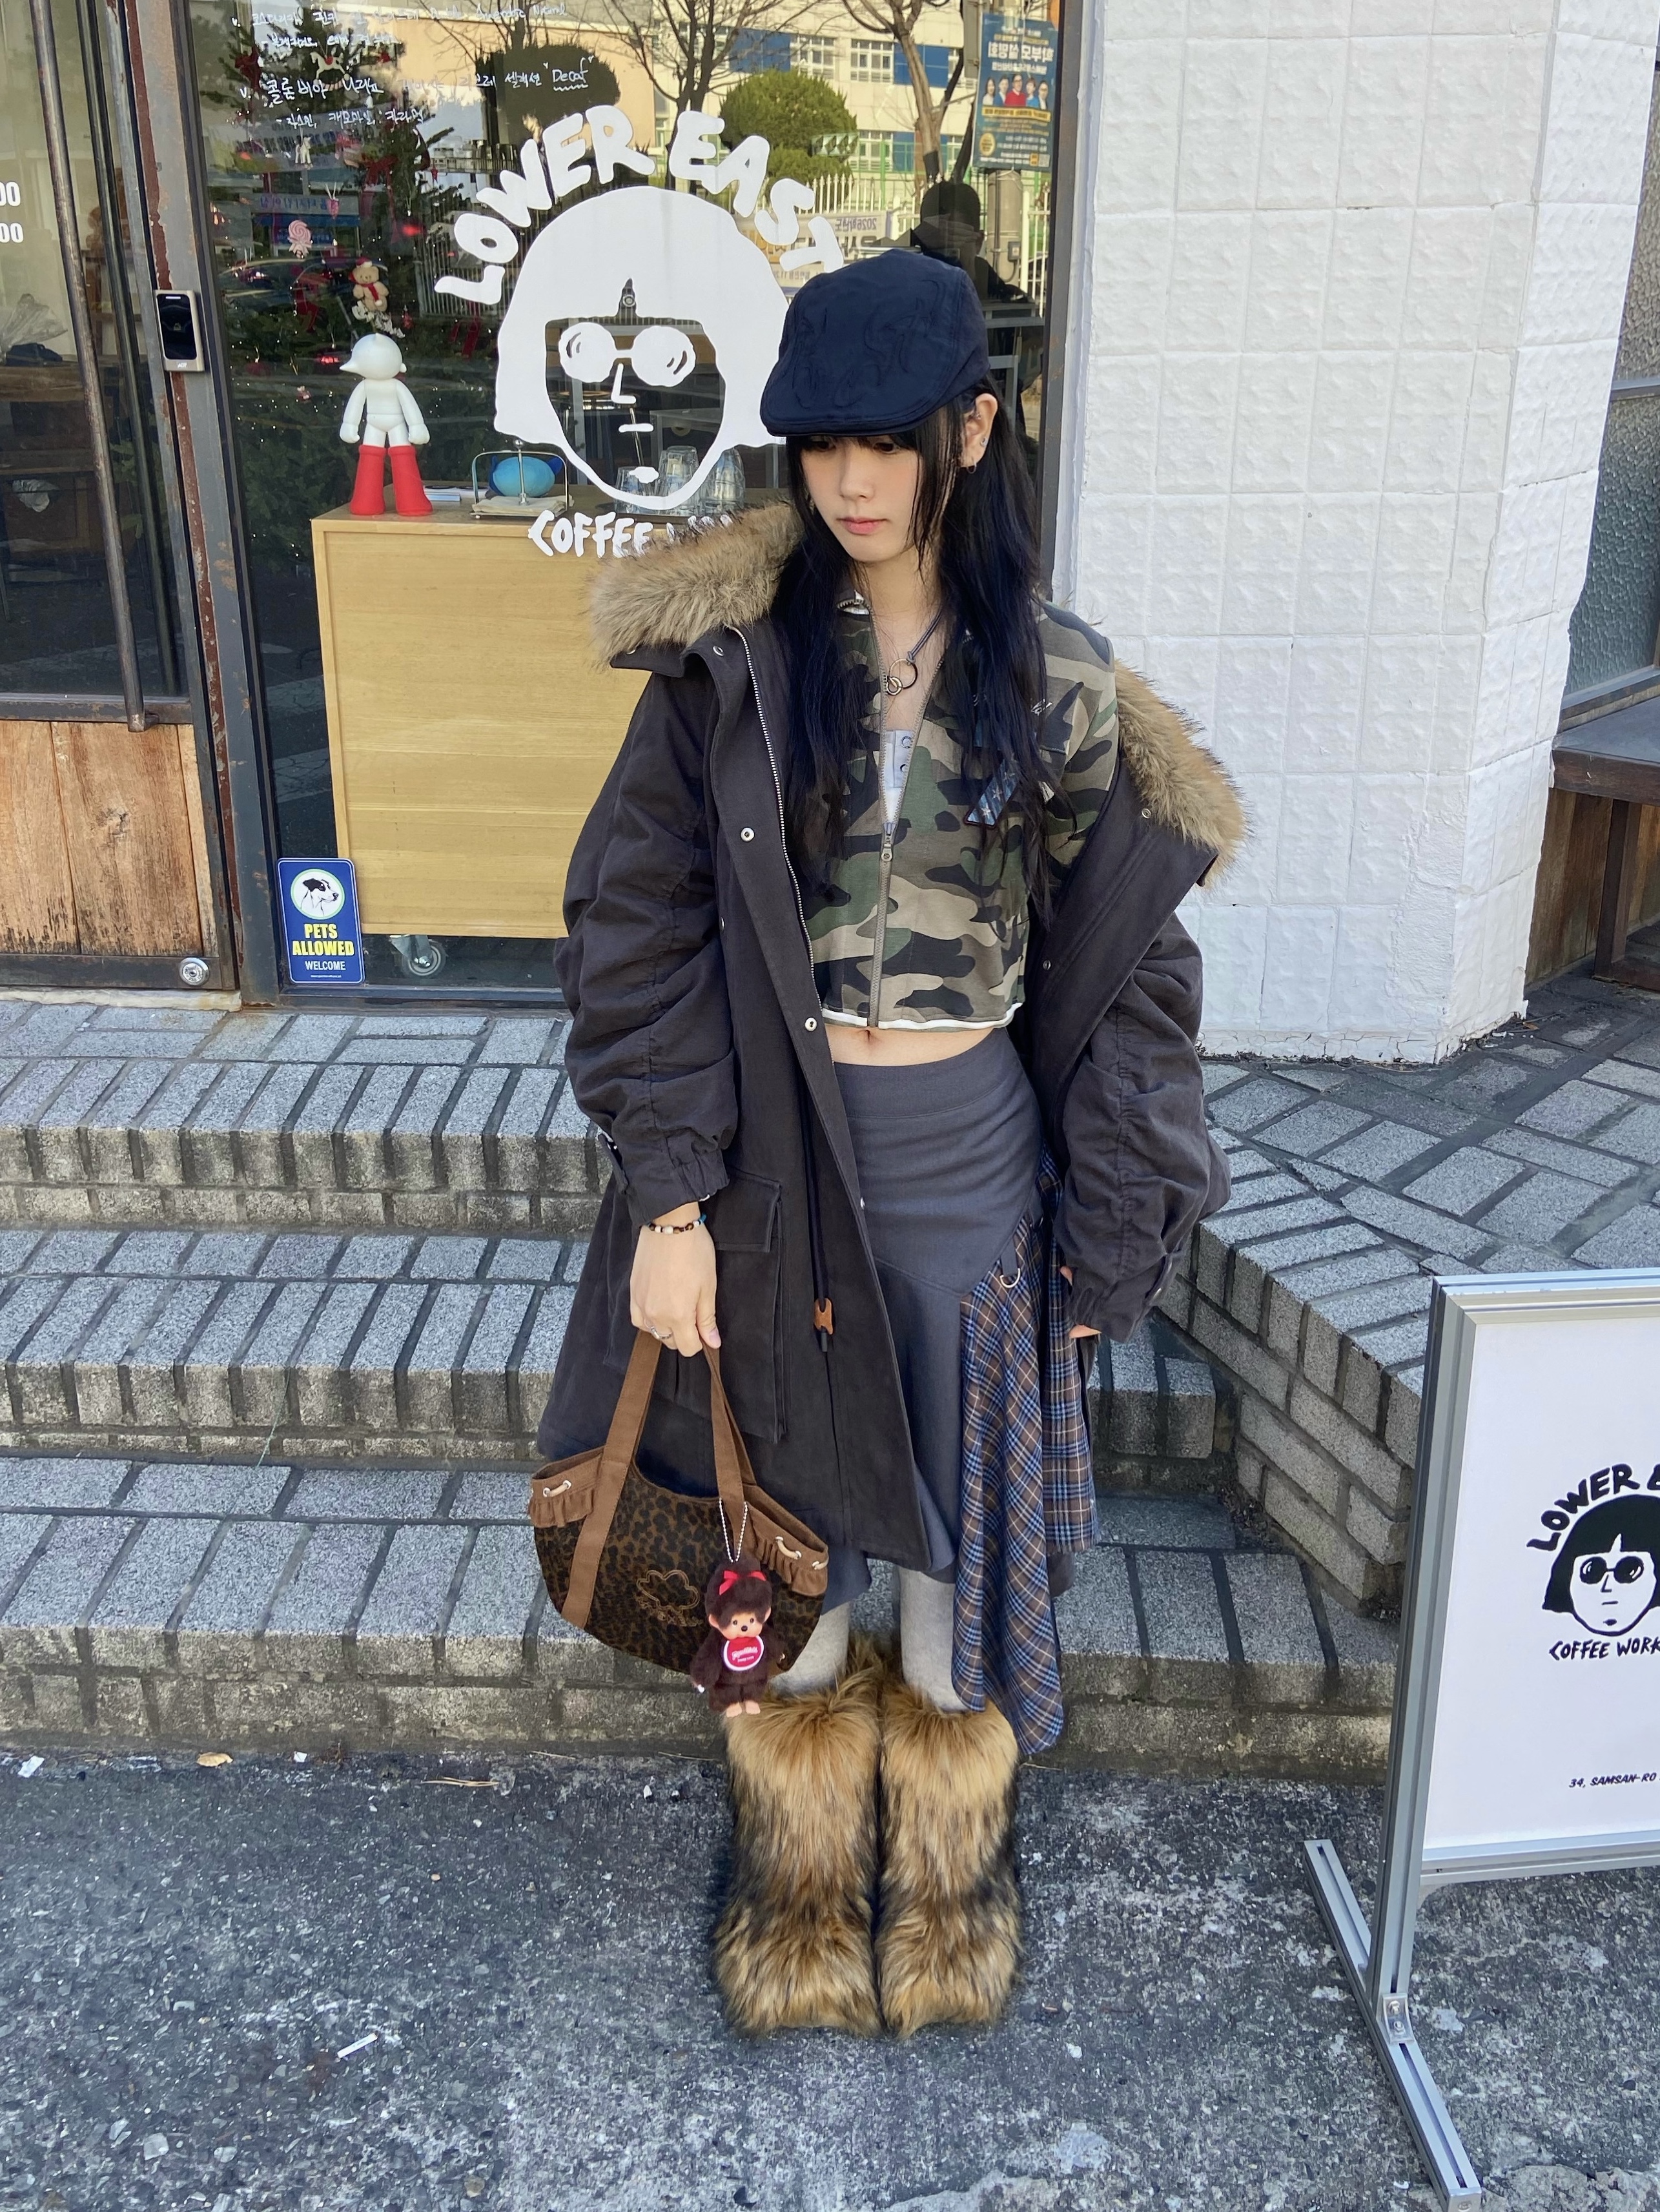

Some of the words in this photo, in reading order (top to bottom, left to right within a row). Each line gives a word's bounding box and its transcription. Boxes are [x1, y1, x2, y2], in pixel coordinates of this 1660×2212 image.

[434, 105, 656, 305] LOWER
[668, 110, 845, 274] EAST
[528, 509, 653, 558] COFFEE
[303, 923, 338, 939] PETS
[292, 941, 355, 956] ALLOWED
[305, 961, 346, 971] WELCOME
[1526, 1463, 1641, 1551] LOWER
[1548, 1639, 1610, 1661] COFFEE
[1569, 1777, 1586, 1788] 34,
